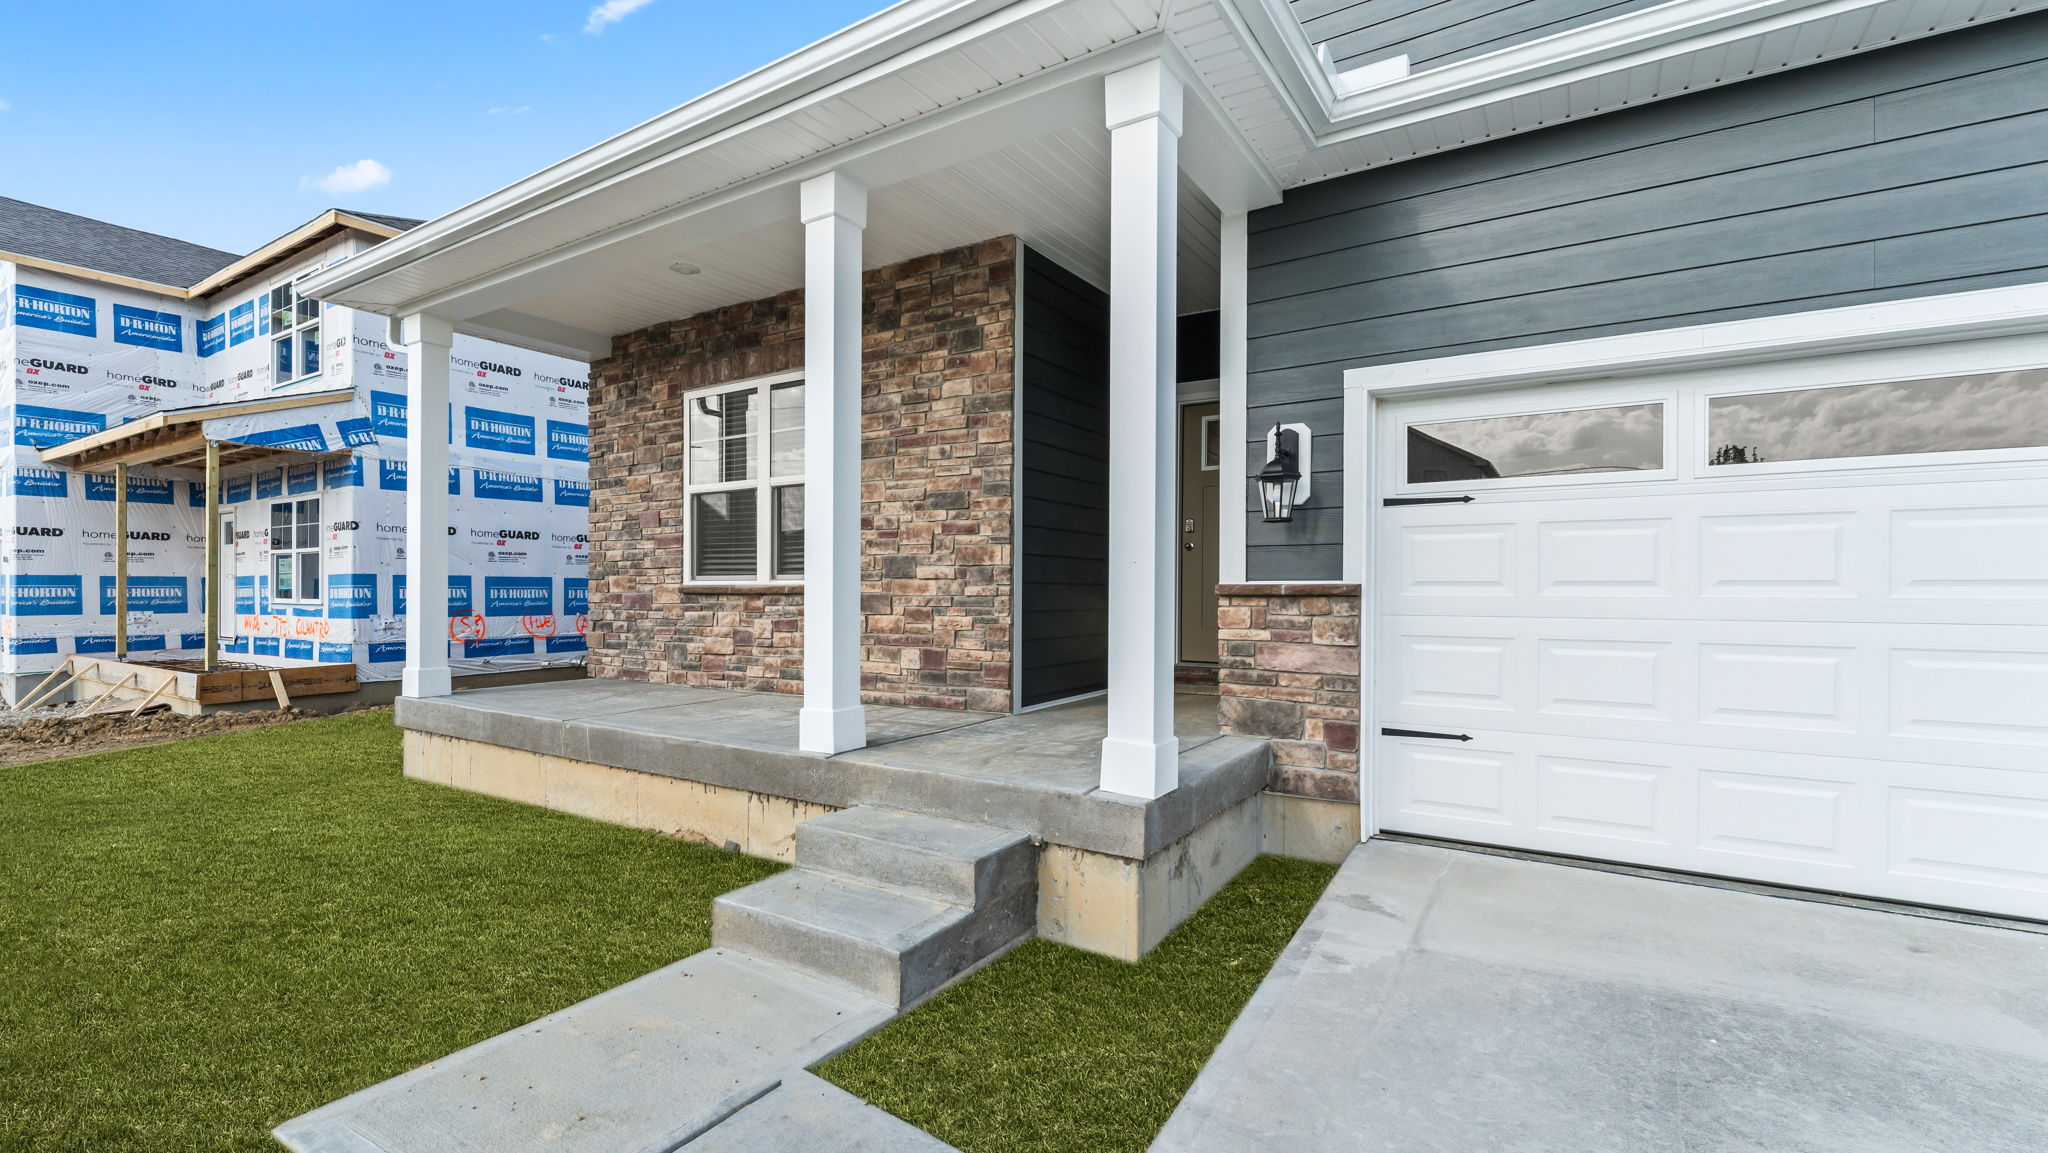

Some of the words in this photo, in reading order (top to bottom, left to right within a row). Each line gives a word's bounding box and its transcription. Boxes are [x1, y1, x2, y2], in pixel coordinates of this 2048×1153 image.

[450, 355, 522, 376] homeGUARD
[28, 379, 70, 389] oxep.com
[478, 382, 509, 391] oxep.com
[471, 432, 505, 442] America's
[505, 436, 532, 445] Builder
[552, 443, 581, 452] America's
[23, 479, 61, 487] Builder
[480, 481, 513, 490] America's
[82, 529, 171, 541] homeUARD
[470, 528, 540, 540] homeGUARD
[490, 600, 523, 608] America's
